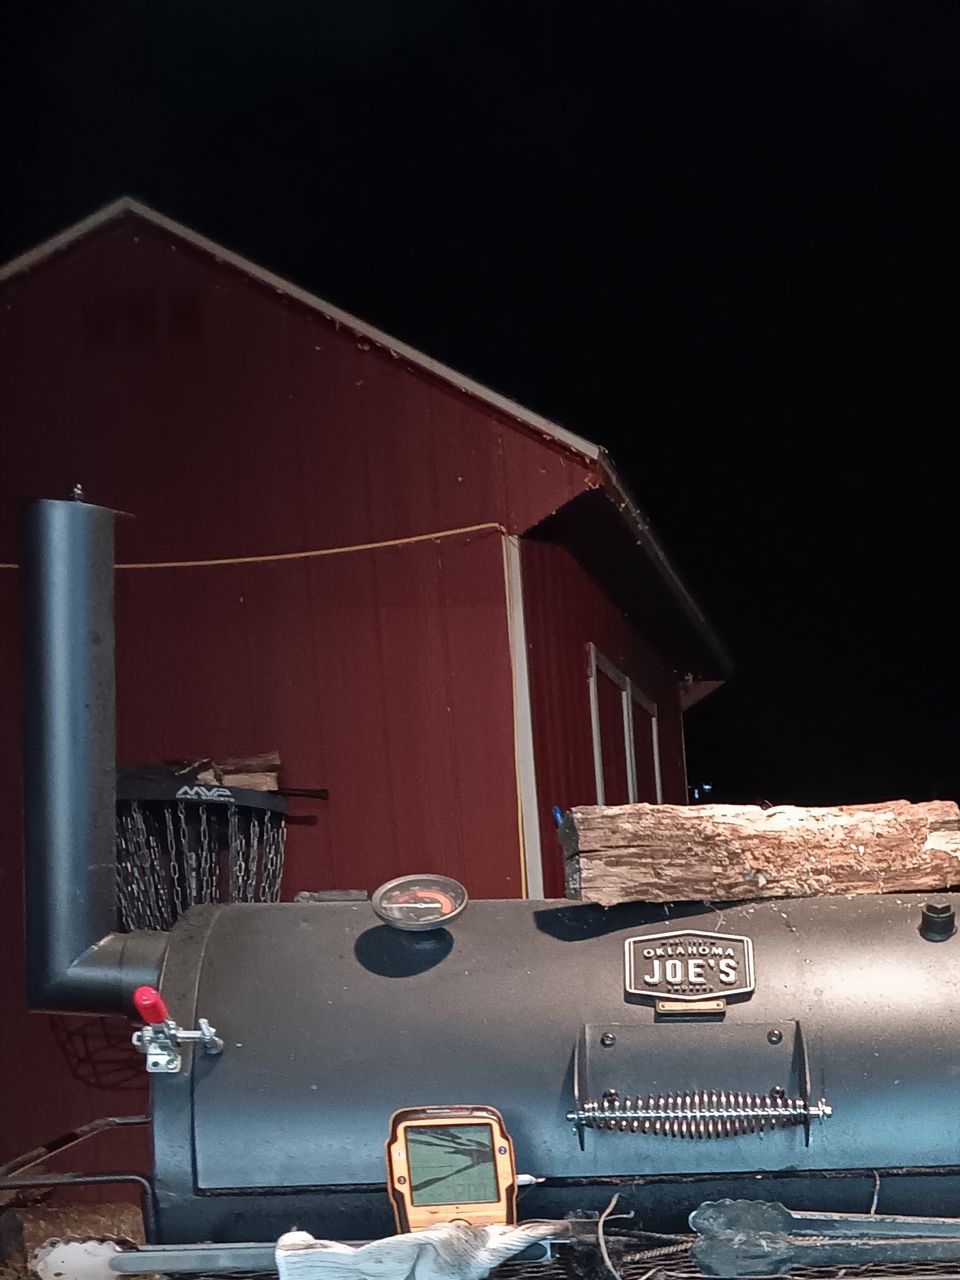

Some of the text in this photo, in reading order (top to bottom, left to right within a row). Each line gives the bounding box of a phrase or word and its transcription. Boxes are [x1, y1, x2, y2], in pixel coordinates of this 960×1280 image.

[176, 786, 231, 797] MVP
[643, 946, 734, 957] OKLAHOMA
[643, 959, 738, 984] JOE'S
